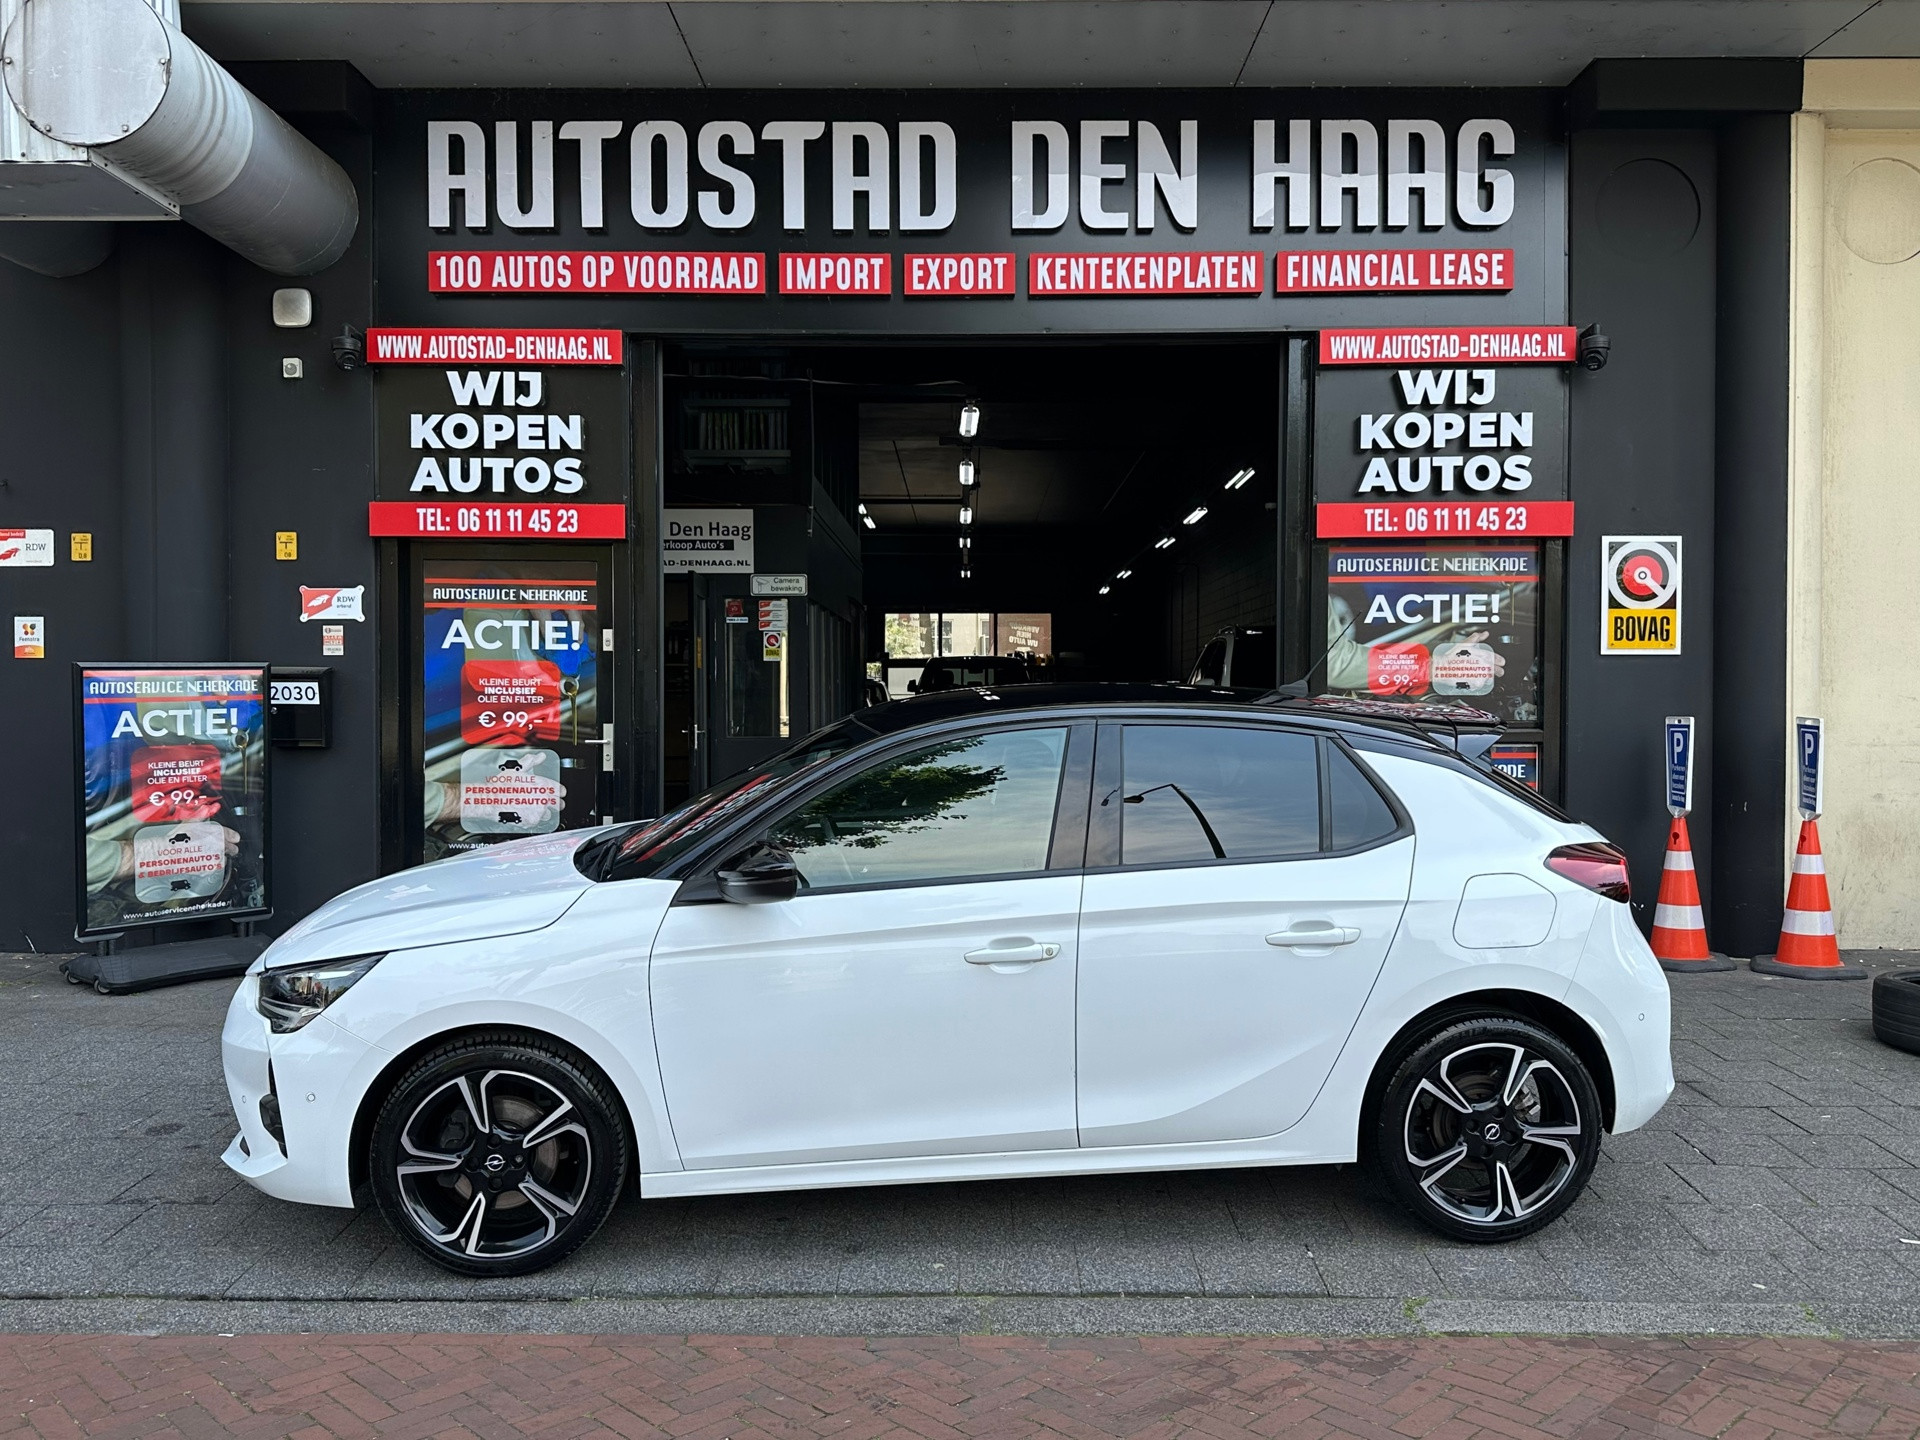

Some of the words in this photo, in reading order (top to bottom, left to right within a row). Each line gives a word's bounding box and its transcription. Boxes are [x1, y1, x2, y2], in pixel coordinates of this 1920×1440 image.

[428, 120, 957, 231] AUTOSTAD
[1011, 120, 1198, 229] DEN
[1252, 119, 1515, 227] HAAG
[435, 255, 482, 288] 100
[491, 256, 572, 289] AUTOS
[582, 256, 615, 289] OP
[623, 256, 760, 290] VOORRAAD
[786, 257, 884, 291] IMPORT
[912, 257, 1007, 292] EXPORT
[1036, 256, 1257, 290] KENTEKENPLATEN
[1286, 253, 1420, 288] FINANCIAL
[1429, 252, 1504, 286] LEASE
[377, 335, 612, 360] WWW.AUTOSTAD-DENHAAG.NL
[1330, 334, 1566, 360] WWW.AUTOSTAD-DENHAAG.NL
[446, 370, 542, 407] WIJ
[1398, 369, 1496, 406] WIJ
[410, 412, 583, 450] KOPEN
[1360, 412, 1534, 450] KOPEN
[409, 456, 584, 494] AUTOS
[1358, 454, 1532, 492] AUTOS
[416, 508, 450, 532] TEL:
[457, 508, 480, 532] 06
[485, 508, 500, 532] 11
[506, 508, 522, 532] 11
[528, 509, 552, 532] 45
[556, 509, 578, 533] 23
[670, 521, 704, 536] Den
[708, 521, 752, 541] Haag
[1364, 508, 1398, 532] TEL:
[1405, 508, 1428, 532] 06
[1434, 508, 1449, 532] 11
[1455, 508, 1470, 531] 11
[1476, 507, 1500, 531] 45
[1505, 506, 1527, 530] 23
[694, 540, 724, 549] Auto's
[1336, 558, 1439, 572] AUTOSERVICE
[1443, 557, 1528, 572] NEHERKADE
[432, 588, 516, 600] AUTOSERVICE
[520, 589, 588, 602] NEHERKADE
[1364, 594, 1500, 624] ACTIE!
[441, 619, 581, 651] ACTIE!
[1613, 615, 1671, 642] BOVAG
[90, 680, 183, 695] AUTOSERVICE
[187, 679, 258, 693] NEHERKADE
[479, 678, 510, 686] KLEINE
[512, 678, 542, 686] BEURT
[484, 687, 536, 695] INCLUSIEF
[1378, 674, 1390, 685] €
[271, 686, 316, 701] 2030
[478, 695, 498, 703] OLIE
[500, 695, 512, 703] EN
[514, 695, 544, 704] FILTER
[112, 708, 238, 738] ACTIE!
[478, 711, 496, 728] €
[502, 711, 543, 730] 99,-
[1674, 732, 1684, 764] P
[1805, 733, 1814, 766] P
[153, 768, 201, 777] INCLUSIEF
[178, 760, 205, 768] BEURT
[182, 775, 208, 783] FILTER
[149, 792, 165, 806] €
[170, 790, 207, 805] 99,-
[139, 853, 220, 868] PERSONENAUTO'S
[147, 863, 222, 877] BEDRIJFSAUTO'S
